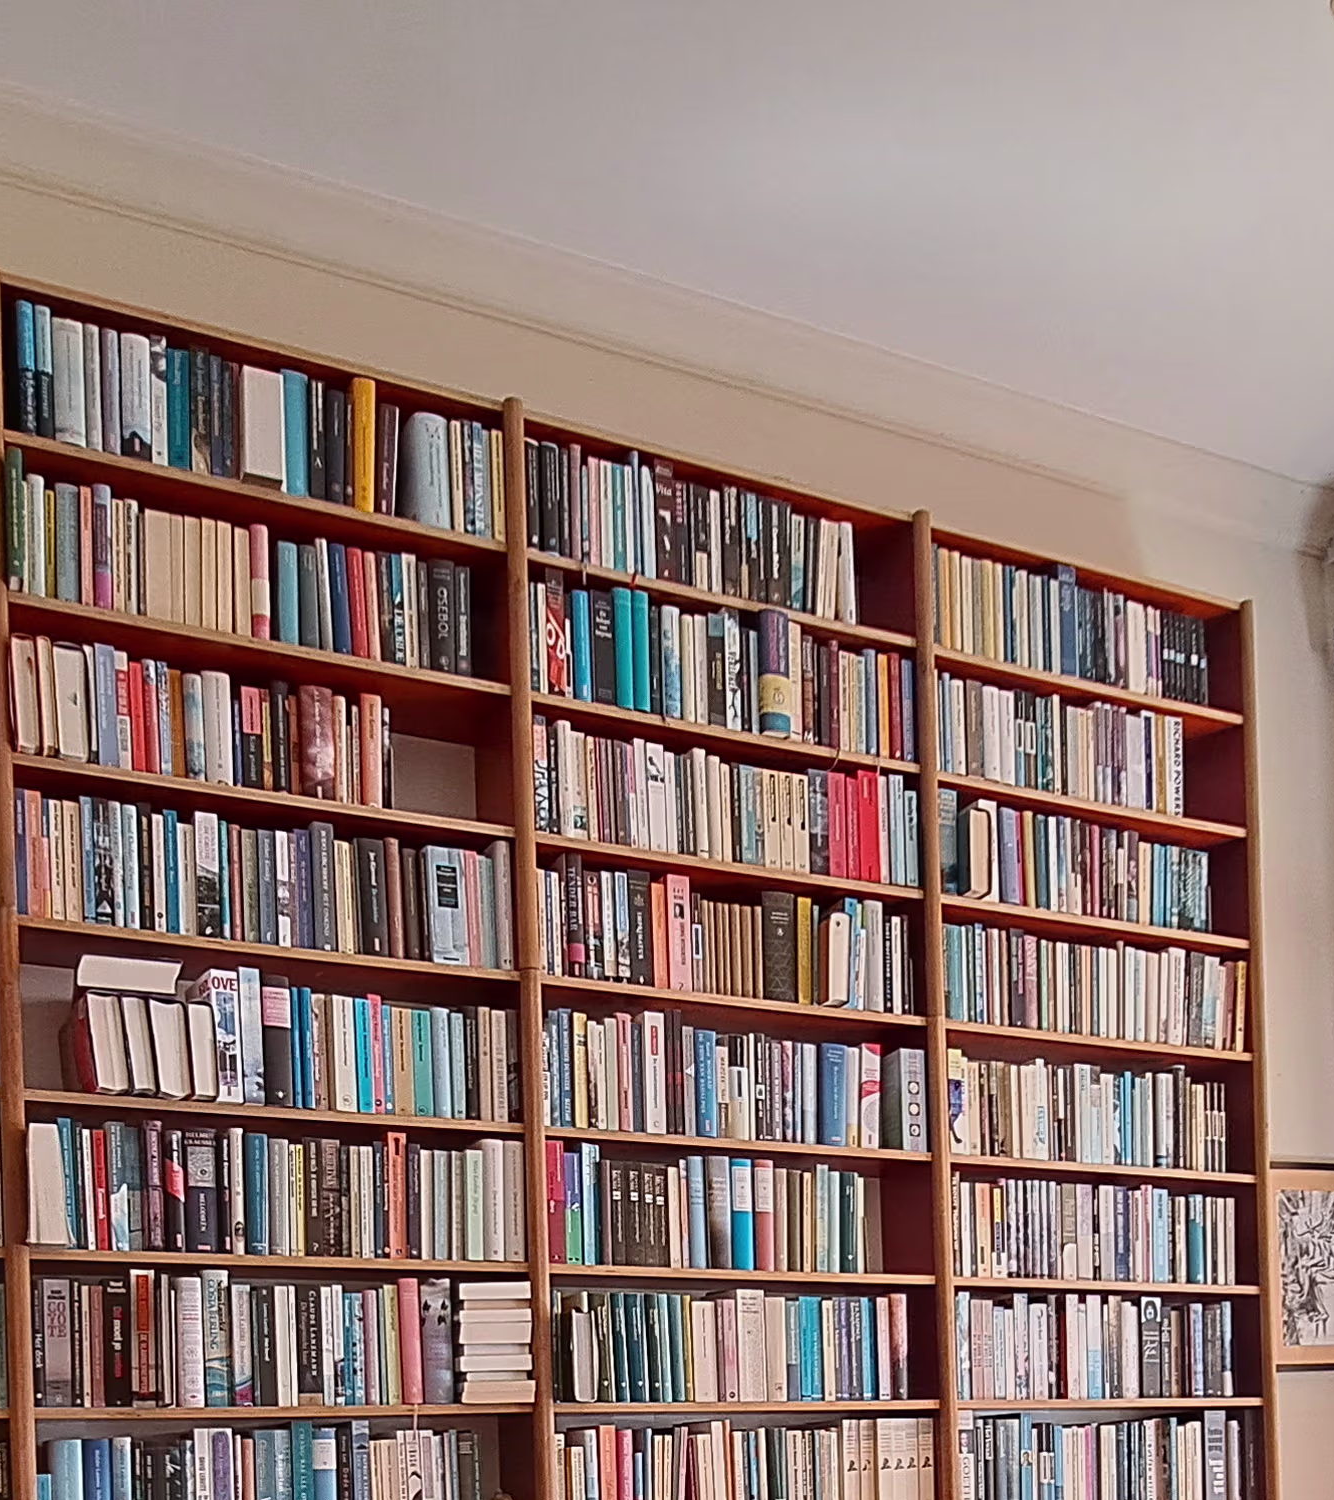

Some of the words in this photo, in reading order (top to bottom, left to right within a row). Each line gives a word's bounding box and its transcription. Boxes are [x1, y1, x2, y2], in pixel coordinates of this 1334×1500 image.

[437, 587, 450, 640] OSEBOL
[1171, 721, 1182, 767] RICHARD
[1171, 769, 1182, 817] POWERS
[308, 1291, 317, 1324] CLAUDE
